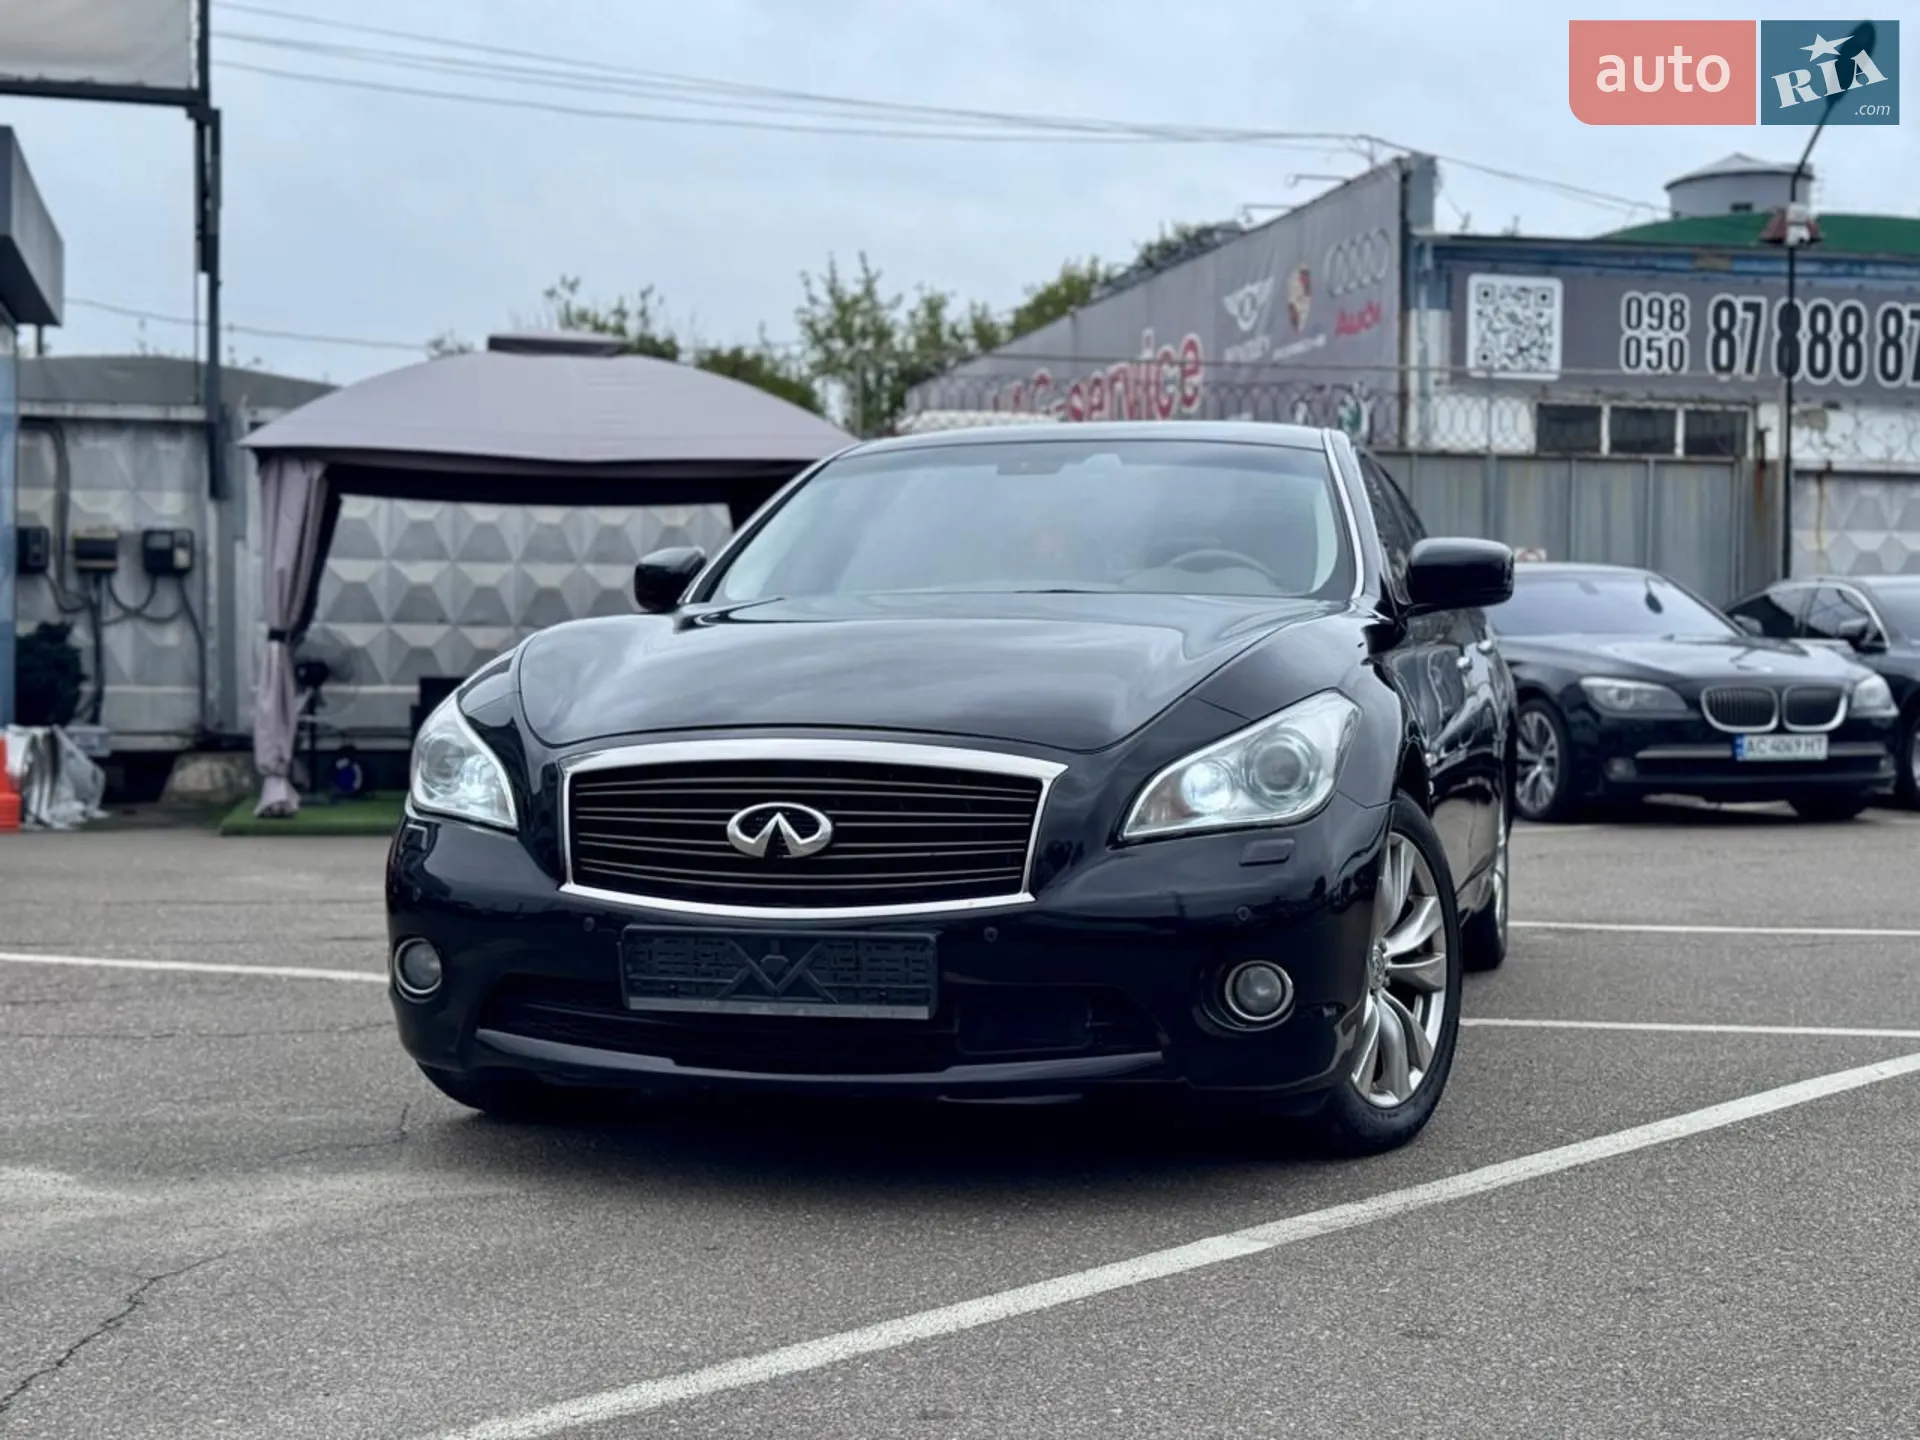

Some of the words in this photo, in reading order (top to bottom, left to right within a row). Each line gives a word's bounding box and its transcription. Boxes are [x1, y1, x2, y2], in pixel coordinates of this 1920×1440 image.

[1622, 292, 1689, 333] 098
[1620, 333, 1688, 374] 050
[1706, 294, 1767, 381] 87
[1772, 298, 1868, 386] 888
